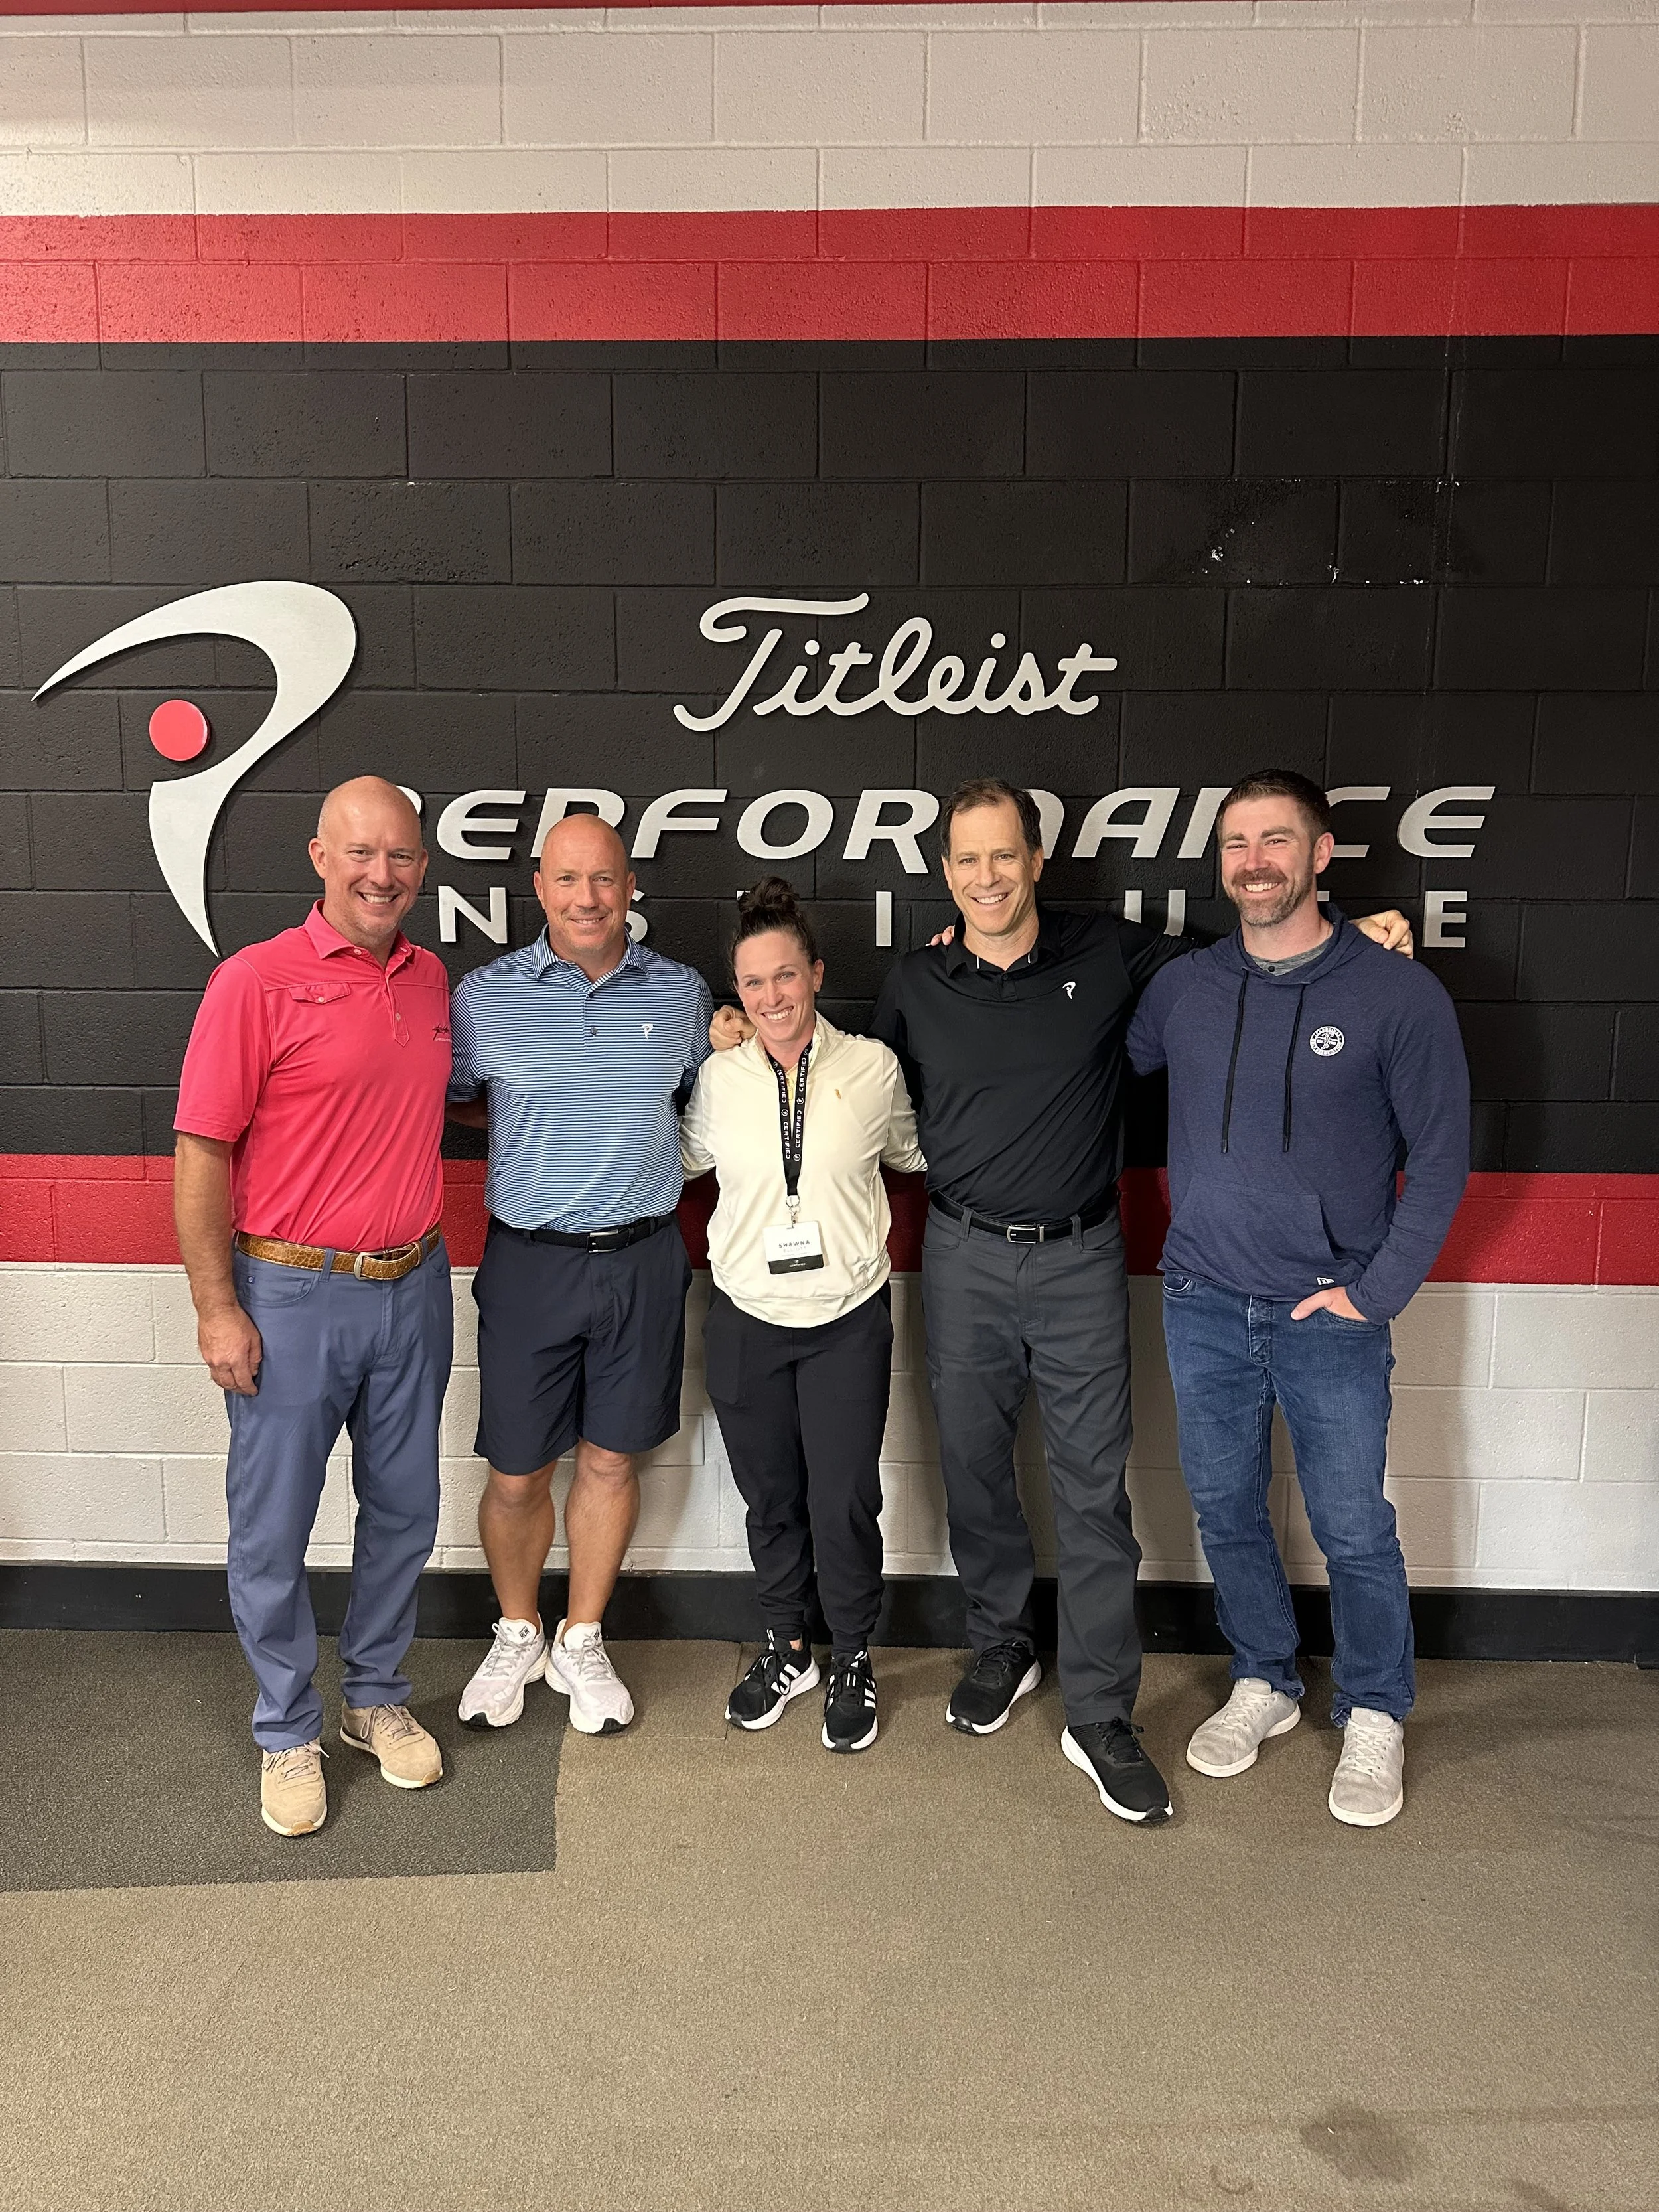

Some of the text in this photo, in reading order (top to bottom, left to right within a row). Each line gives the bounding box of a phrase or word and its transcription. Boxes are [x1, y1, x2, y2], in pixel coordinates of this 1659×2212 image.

[672, 593, 1118, 731] Titleist
[396, 786, 1496, 874] ERFORACE
[777, 1069, 786, 1103] CERTIFIED
[778, 1240, 810, 1248] SHAWNA
